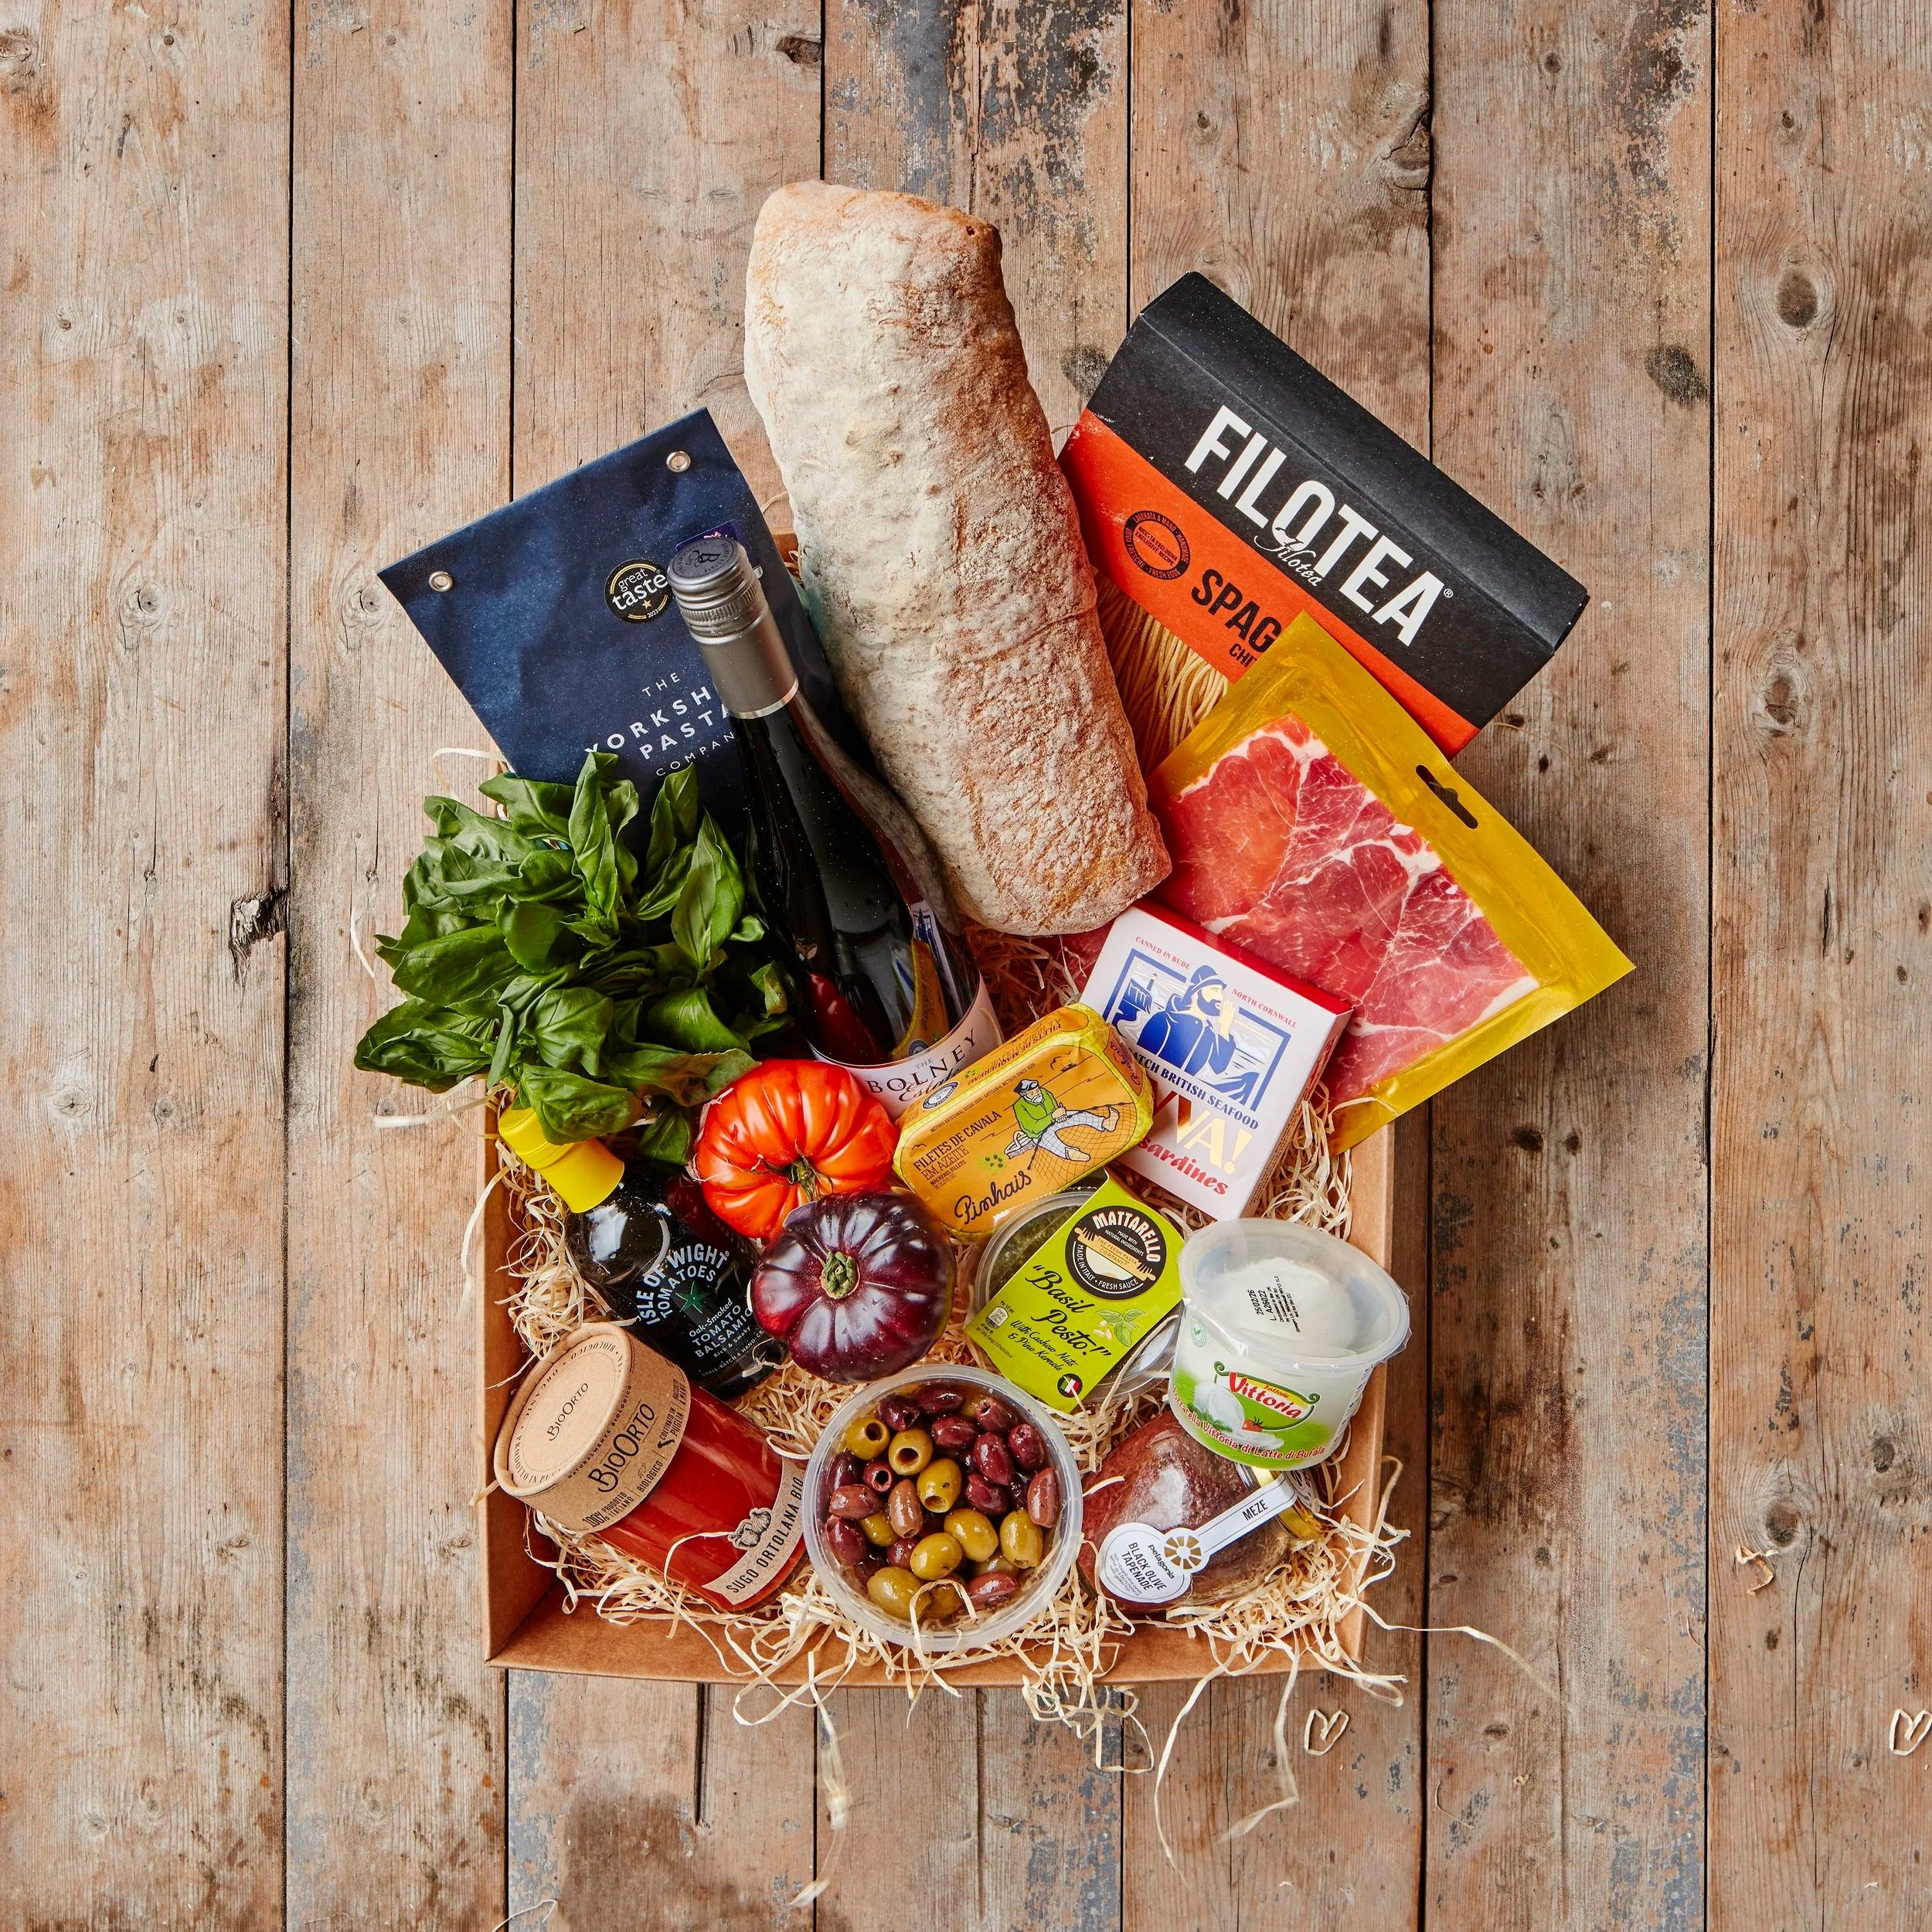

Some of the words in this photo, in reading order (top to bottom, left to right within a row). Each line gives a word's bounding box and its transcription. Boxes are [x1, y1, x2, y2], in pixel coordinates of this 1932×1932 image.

[1162, 518, 1175, 531] MANO
[1127, 544, 1145, 568] FRESCHE
[1135, 531, 1158, 553] EXCLUSIVE
[1158, 551, 1175, 566] RECIPE
[1155, 540, 1177, 561] ESCLUSIVA
[618, 568, 648, 592] great
[1148, 567, 1167, 579] FRESH
[1167, 568, 1180, 579] EGGS
[612, 574, 668, 610] taste
[647, 609, 658, 617] 2023
[1192, 569, 1281, 653] SPAG
[1229, 643, 1257, 668] CHI
[642, 672, 680, 697] THE
[1135, 936, 1162, 954] CANNED
[1163, 951, 1170, 959] IN
[1172, 955, 1190, 971] BUDE
[1232, 989, 1257, 1006] NORTH
[1257, 1003, 1298, 1029] CORNWALL
[1022, 1042, 1031, 1052] DE
[1033, 1023, 1061, 1043] FILETS
[866, 1027, 977, 1094] BOLNEY
[915, 1058, 933, 1070] THE
[968, 1050, 1019, 1085] MAQUEREAU
[945, 1109, 964, 1124] ARTESANAL
[963, 1102, 975, 1114] DESDE
[984, 1085, 1002, 1100] ARTISANAL
[1002, 1075, 1017, 1088] METHOD
[1016, 1069, 1028, 1080] SINCE
[1128, 1048, 1159, 1073] ATCH
[1161, 1068, 1206, 1100] BRITISH
[1208, 1095, 1259, 1130] SEAFOOD
[913, 1141, 951, 1172] FILETES
[949, 1132, 966, 1147] DE
[964, 1111, 1002, 1138] CAVALA
[921, 1165, 939, 1181] EM
[940, 1145, 969, 1171] AZEITE
[930, 1168, 951, 1186] MACKEREL
[949, 1160, 966, 1174] FILLETS
[1138, 1137, 1230, 1196] sardines
[954, 1170, 1032, 1225] Pinhais
[1092, 1211, 1161, 1262] MATTARELLO
[1097, 1237, 1107, 1246] THE
[1107, 1243, 1123, 1257] FRESH
[1123, 1253, 1137, 1264] PASTA
[1105, 1230, 1121, 1243] NATURAL
[1121, 1240, 1145, 1257] INGREDIENTS
[1128, 1236, 1138, 1245] WITH
[643, 1264, 668, 1287] OF
[1082, 1267, 1095, 1281] ITALY
[1098, 1280, 1117, 1290] FRESH
[1119, 1278, 1138, 1290] SAUCE
[636, 1290, 660, 1325] ISLE
[658, 1265, 716, 1319] TOMATOES
[1247, 1290, 1264, 1315] 25/02/26
[1258, 1291, 1274, 1314] A26022
[689, 1298, 733, 1337] Oak-Smoked
[692, 1304, 740, 1346] TOMATO
[695, 1308, 753, 1357] BALSAMIC
[713, 1348, 727, 1358] Rich
[733, 1326, 750, 1343] Smoky
[1010, 1320, 1033, 1335] With
[1029, 1332, 1056, 1352] Cashew
[1055, 1352, 1078, 1367] Nuts
[1015, 1337, 1035, 1352] Pine
[1032, 1350, 1063, 1372] Kernels
[701, 1355, 736, 1376] SMALL-BATCH
[1229, 1371, 1302, 1419] Vittoria
[1264, 1384, 1289, 1399] Fattorie
[567, 1429, 611, 1479] NATURALMENTE
[611, 1385, 632, 1427] BIOLOGICO
[660, 1413, 675, 1440] COLTIVATO
[668, 1406, 676, 1415] IN
[671, 1411, 685, 1437] PUGLIA
[1202, 1421, 1239, 1450] Vittoria
[1241, 1444, 1251, 1454] di
[1253, 1446, 1283, 1459] Latte
[1284, 1449, 1294, 1460] di
[1296, 1446, 1325, 1459] Bufala
[637, 1460, 663, 1493] BIOLOGICO
[602, 1492, 627, 1514] PRODOTTO
[609, 1496, 634, 1518] ITALIANO
[1242, 1498, 1269, 1522] MEZE
[582, 1512, 611, 1528] 100%
[726, 1568, 759, 1594] SUGO
[756, 1503, 799, 1568] ORTOLANA
[791, 1476, 804, 1501] BIO
[1122, 1551, 1153, 1590] TAPENADE
[1129, 1542, 1150, 1570] BLACK
[1145, 1570, 1167, 1590] OLIVE
[1148, 1545, 1175, 1580] pelagonia
